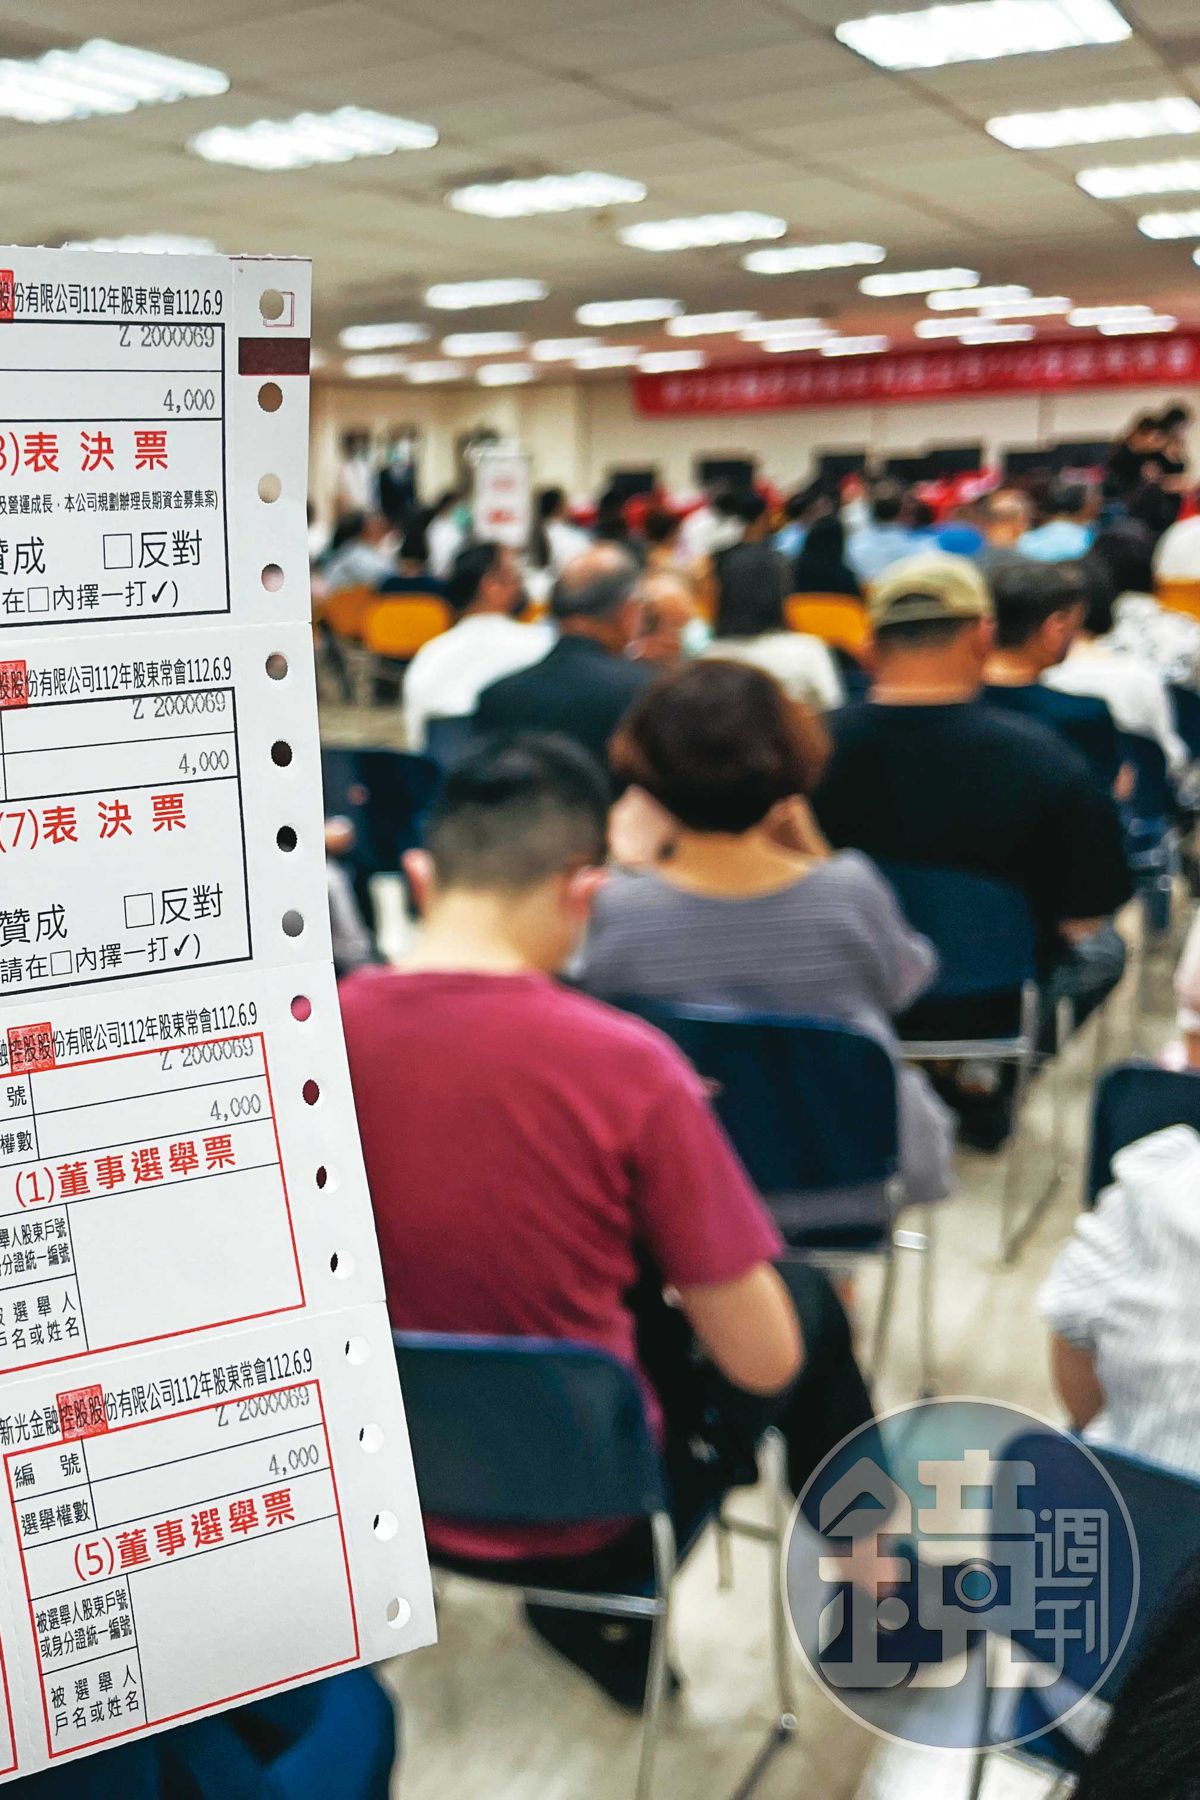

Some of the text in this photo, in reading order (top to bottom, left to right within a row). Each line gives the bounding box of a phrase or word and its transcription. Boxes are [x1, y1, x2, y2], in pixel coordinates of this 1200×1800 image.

[140, 326, 215, 348] 2000069
[163, 389, 215, 412] 4,000
[138, 529, 202, 570] 反對
[154, 692, 226, 718] 2000069
[178, 750, 229, 776] 4,000
[160, 883, 223, 925] 反對
[182, 1038, 254, 1068] 2000069
[211, 1094, 262, 1121] 4,000
[15, 1134, 236, 1208] (1)董事選舉票
[238, 1387, 310, 1422] 2000069
[269, 1444, 320, 1476] 4,000
[21, 1498, 91, 1537] 選舉權數
[74, 1487, 296, 1581] (5)董事選舉票
[36, 1589, 129, 1634] 被選舉人股東戶號
[39, 1617, 133, 1659] 或身分證統一編號
[51, 1665, 137, 1708] 被選舉人
[55, 1690, 140, 1736] 戶名或姓名
